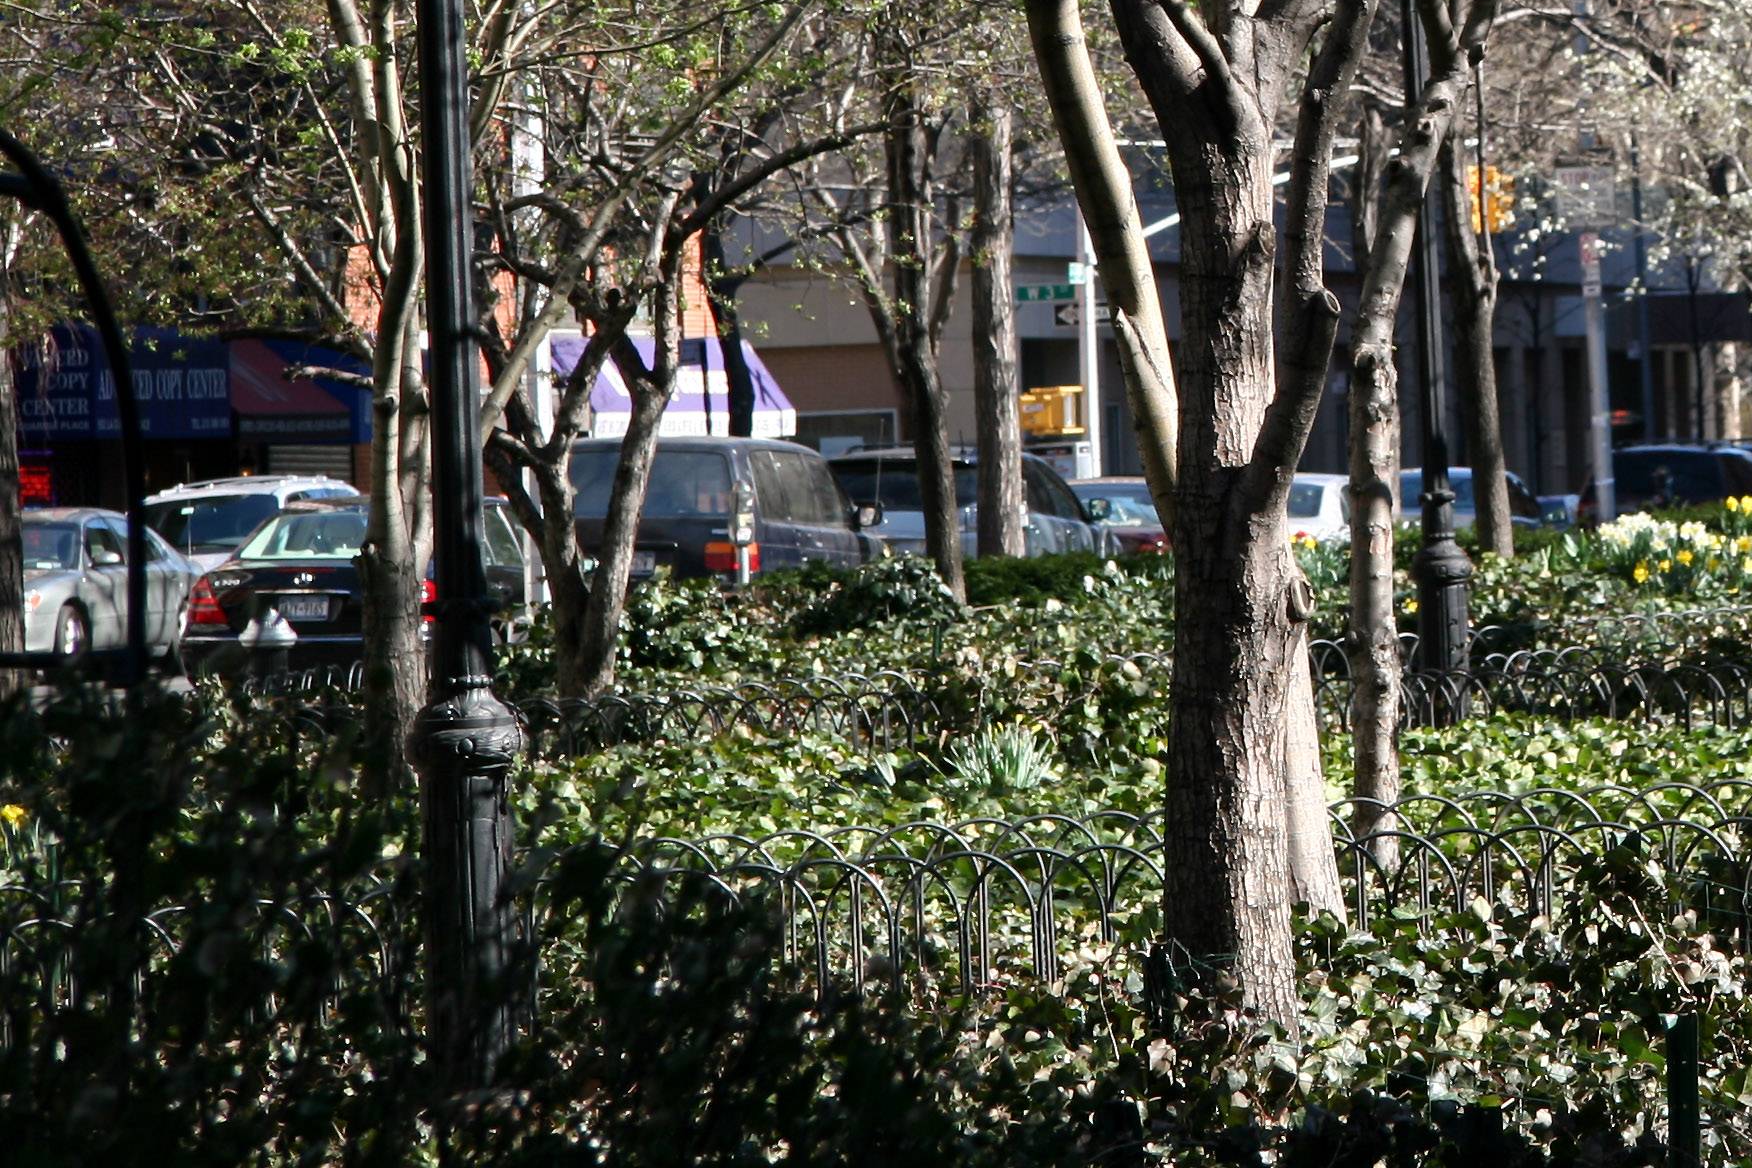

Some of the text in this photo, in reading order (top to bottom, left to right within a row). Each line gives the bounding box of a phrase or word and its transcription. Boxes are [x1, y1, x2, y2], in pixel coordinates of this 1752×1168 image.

[1027, 287, 1039, 300] W
[1045, 285, 1055, 300] 3
[44, 372, 89, 390] COPY
[97, 367, 227, 399] ADCED COPY CENTER
[22, 397, 90, 416] CENTER
